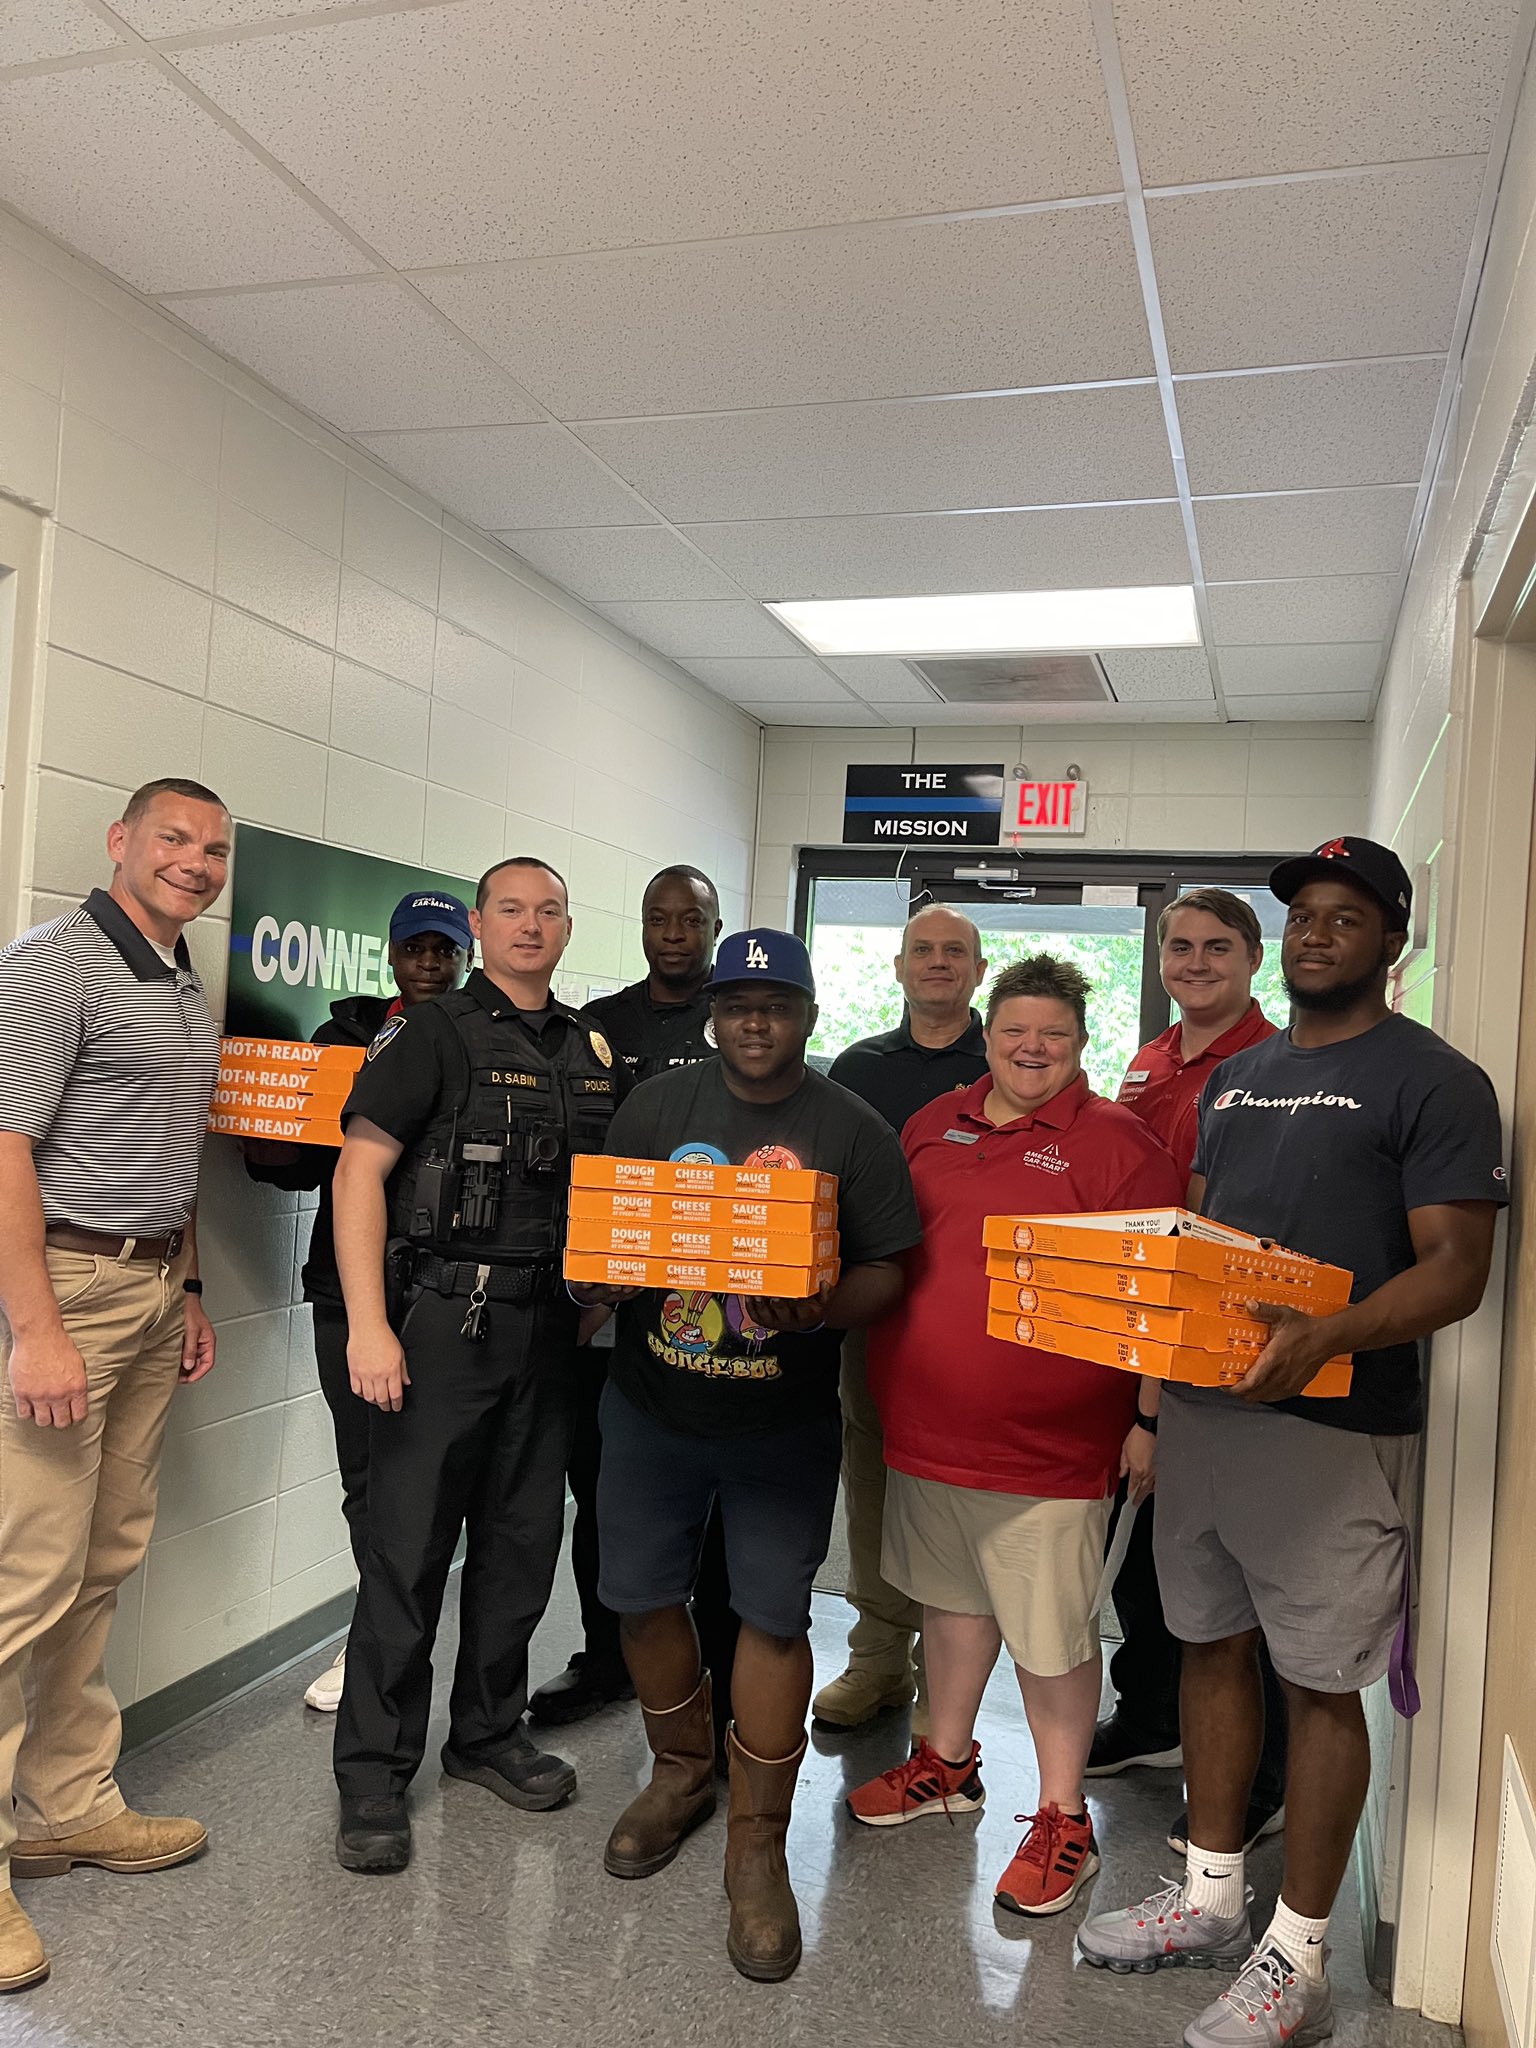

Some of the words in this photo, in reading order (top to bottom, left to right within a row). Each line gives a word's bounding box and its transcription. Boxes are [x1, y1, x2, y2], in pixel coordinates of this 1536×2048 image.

[901, 773, 947, 789] THE
[1017, 783, 1077, 826] EXIT
[873, 820, 968, 836] MISSION
[745, 938, 769, 969] LA
[222, 1041, 322, 1062] HOT-N-READY
[491, 1072, 501, 1083] D.
[505, 1074, 536, 1087] SABIN
[584, 1081, 610, 1092] POLICE
[1213, 1089, 1362, 1115] Champion
[1024, 1150, 1070, 1168] AMERICA'S
[616, 1165, 655, 1176] DOUGH
[675, 1168, 715, 1180] CHEESE
[735, 1172, 771, 1184] SAUCE
[612, 1196, 652, 1207] DOUGH
[671, 1200, 711, 1212] CHEESE
[732, 1204, 767, 1215] SAUCE
[611, 1228, 651, 1240] DOUGH
[671, 1232, 711, 1244] CHEESE
[732, 1236, 768, 1248] SAUCE
[607, 1260, 646, 1271] DOUGH
[666, 1265, 707, 1276] CHEESE
[728, 1268, 763, 1280] SAUCE
